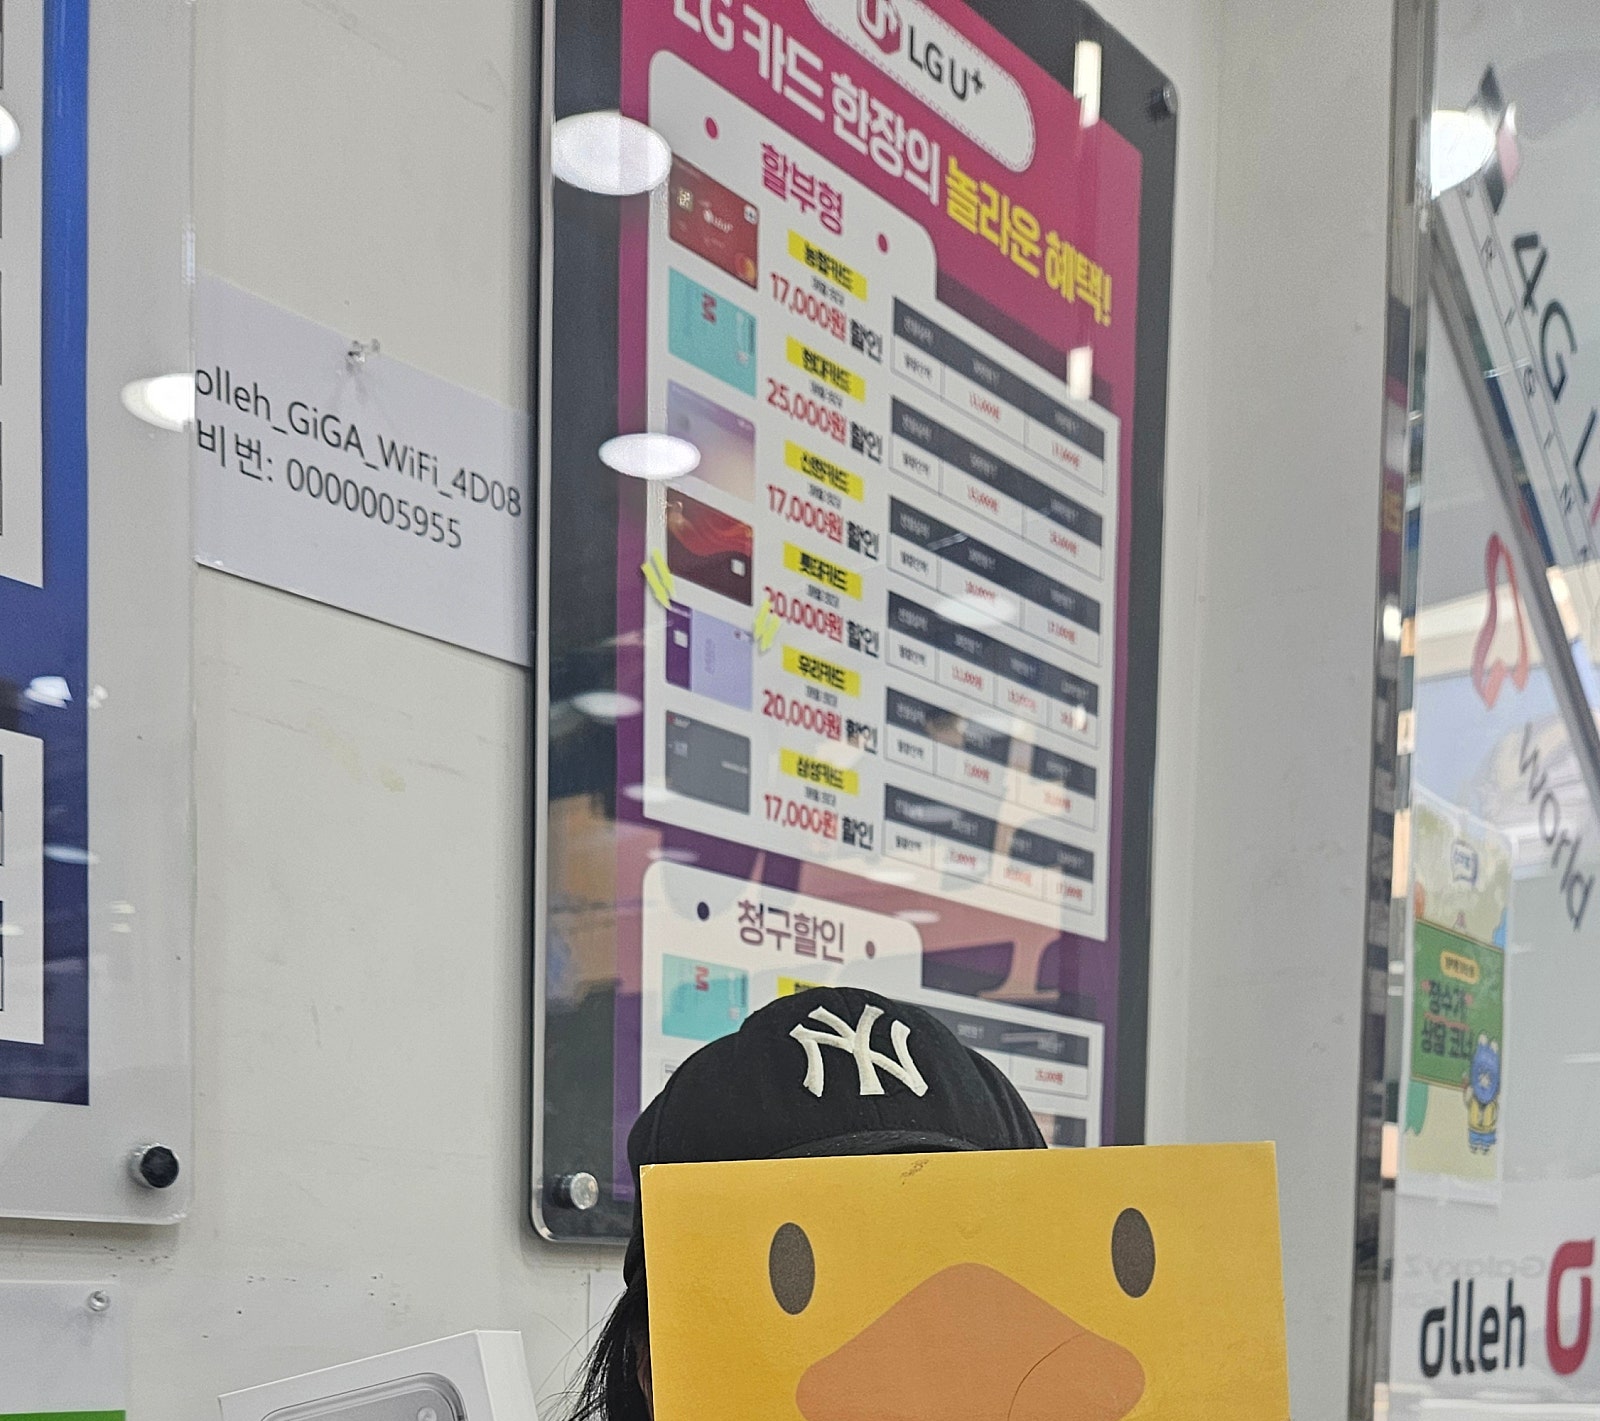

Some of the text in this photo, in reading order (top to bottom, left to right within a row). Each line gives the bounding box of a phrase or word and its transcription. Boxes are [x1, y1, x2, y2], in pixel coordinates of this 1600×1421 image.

[742, 3, 825, 123] 카드
[830, 71, 941, 207] 한장의
[945, 155, 1041, 279] 놀라운
[1043, 229, 1113, 327] 혜택!
[760, 142, 844, 237] 할부형
[769, 271, 846, 343] 17,000원
[849, 318, 883, 364] 할인
[194, 365, 523, 519] olleh_GiGA_WiFi_4D08
[766, 376, 846, 446] 25,000원
[849, 419, 883, 465] 할인
[196, 419, 463, 551] 비번: 0000005955
[767, 483, 843, 545] 17,000원
[846, 519, 880, 562] 할인
[846, 619, 879, 659] 할인
[762, 688, 842, 743] 20,000원
[845, 718, 878, 755] 할인
[763, 794, 839, 842] 17,000원
[842, 815, 874, 852] 할인
[1518, 720, 1597, 932] world
[736, 898, 845, 963] 청구할인
[788, 1003, 929, 1099] NY
[1419, 1278, 1527, 1379] olleh
